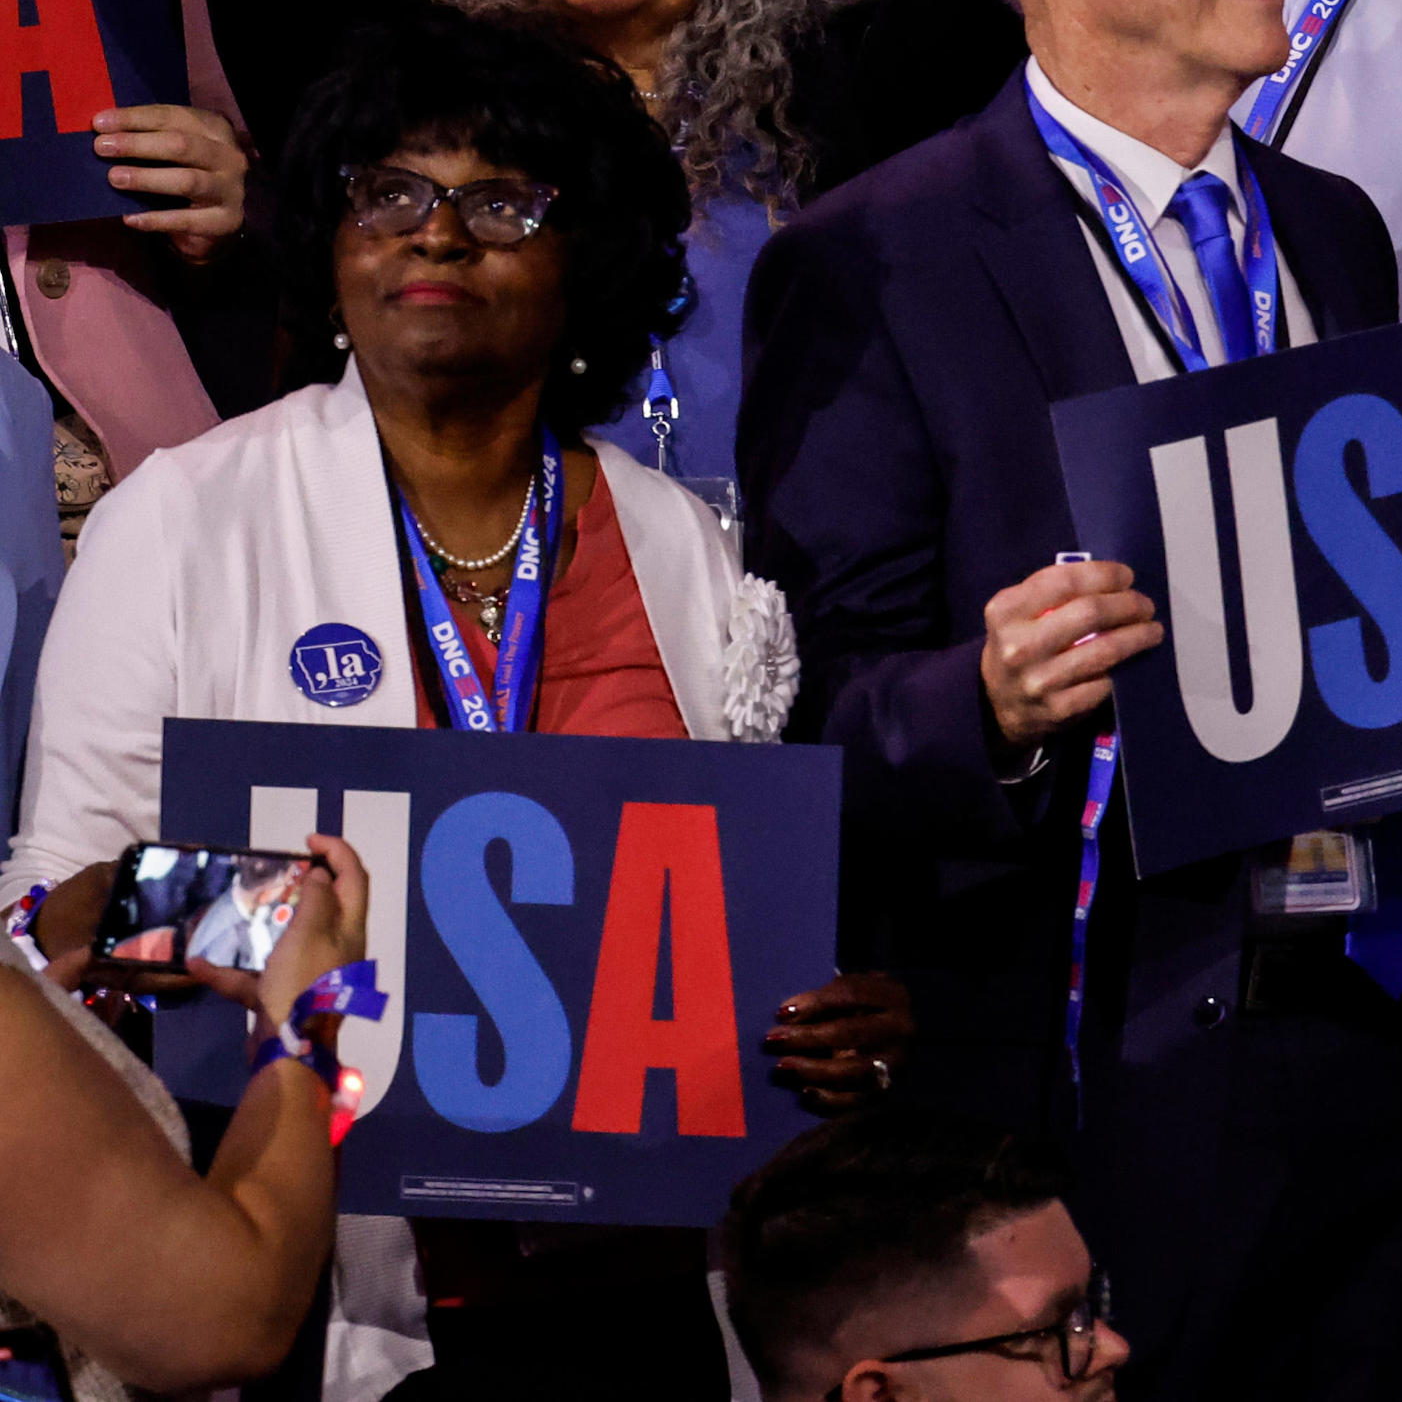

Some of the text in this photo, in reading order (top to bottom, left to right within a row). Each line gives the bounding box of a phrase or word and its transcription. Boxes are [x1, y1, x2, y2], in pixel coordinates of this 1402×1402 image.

[1270, 32, 1312, 85] DNC
[1109, 203, 1146, 264] DNC
[1254, 290, 1271, 351] DNC
[517, 528, 539, 580] DNC
[432, 621, 470, 677] DNC
[249, 785, 745, 1138] USA
